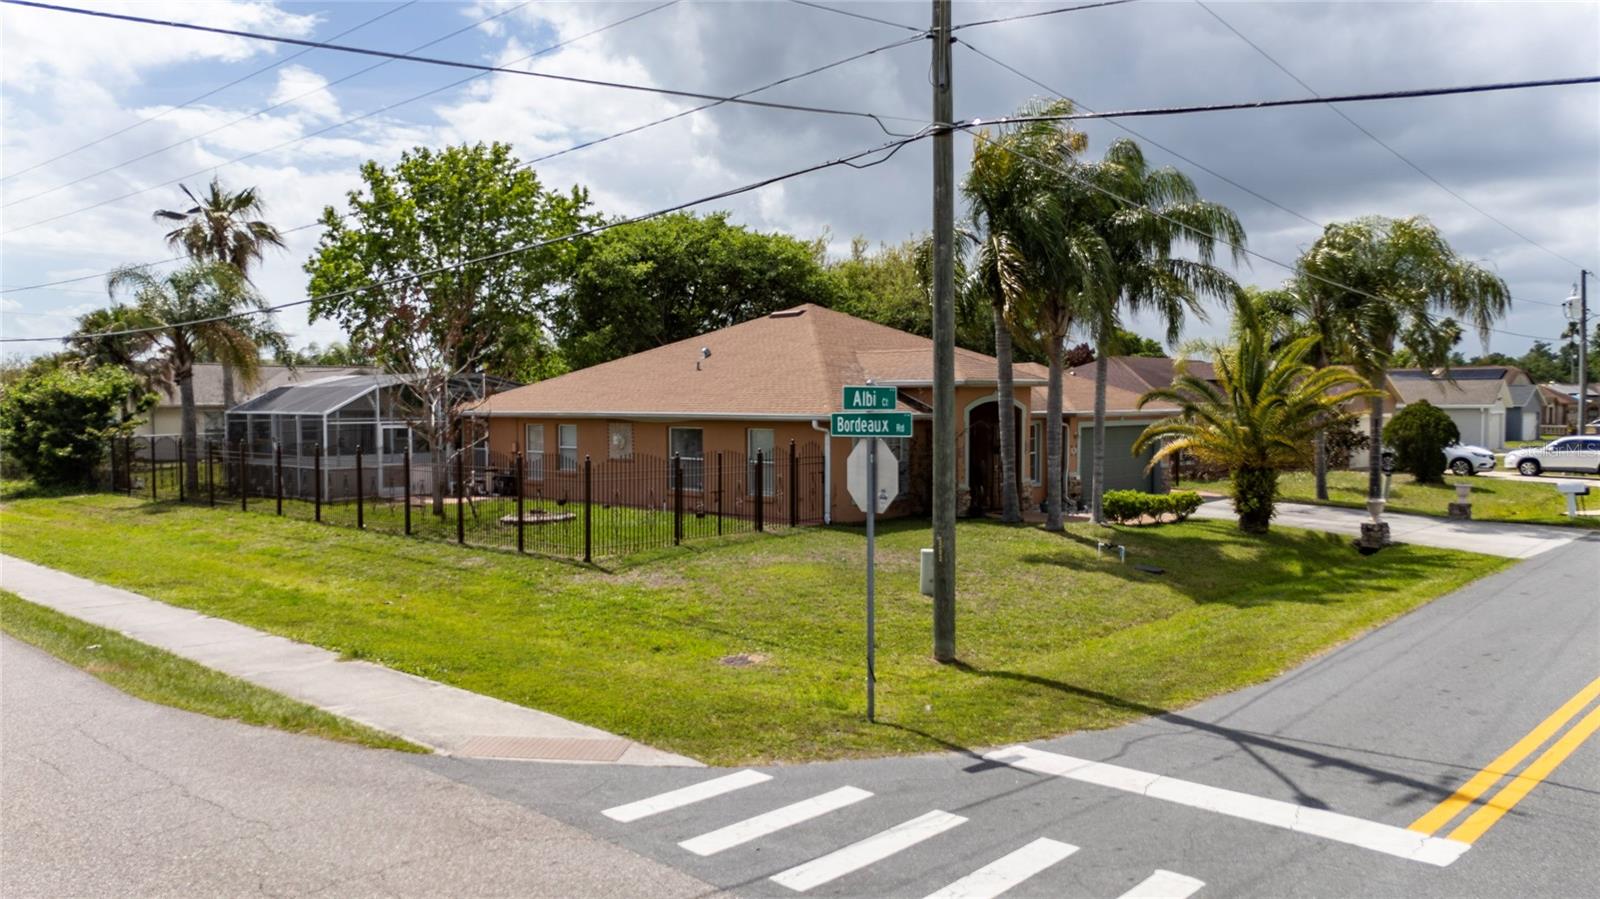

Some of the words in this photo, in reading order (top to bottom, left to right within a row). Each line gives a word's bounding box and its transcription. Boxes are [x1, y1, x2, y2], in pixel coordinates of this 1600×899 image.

[853, 390, 876, 406] Albi
[882, 398, 889, 406] Ct
[837, 417, 889, 432] Bordeaux
[896, 424, 905, 432] Rd
